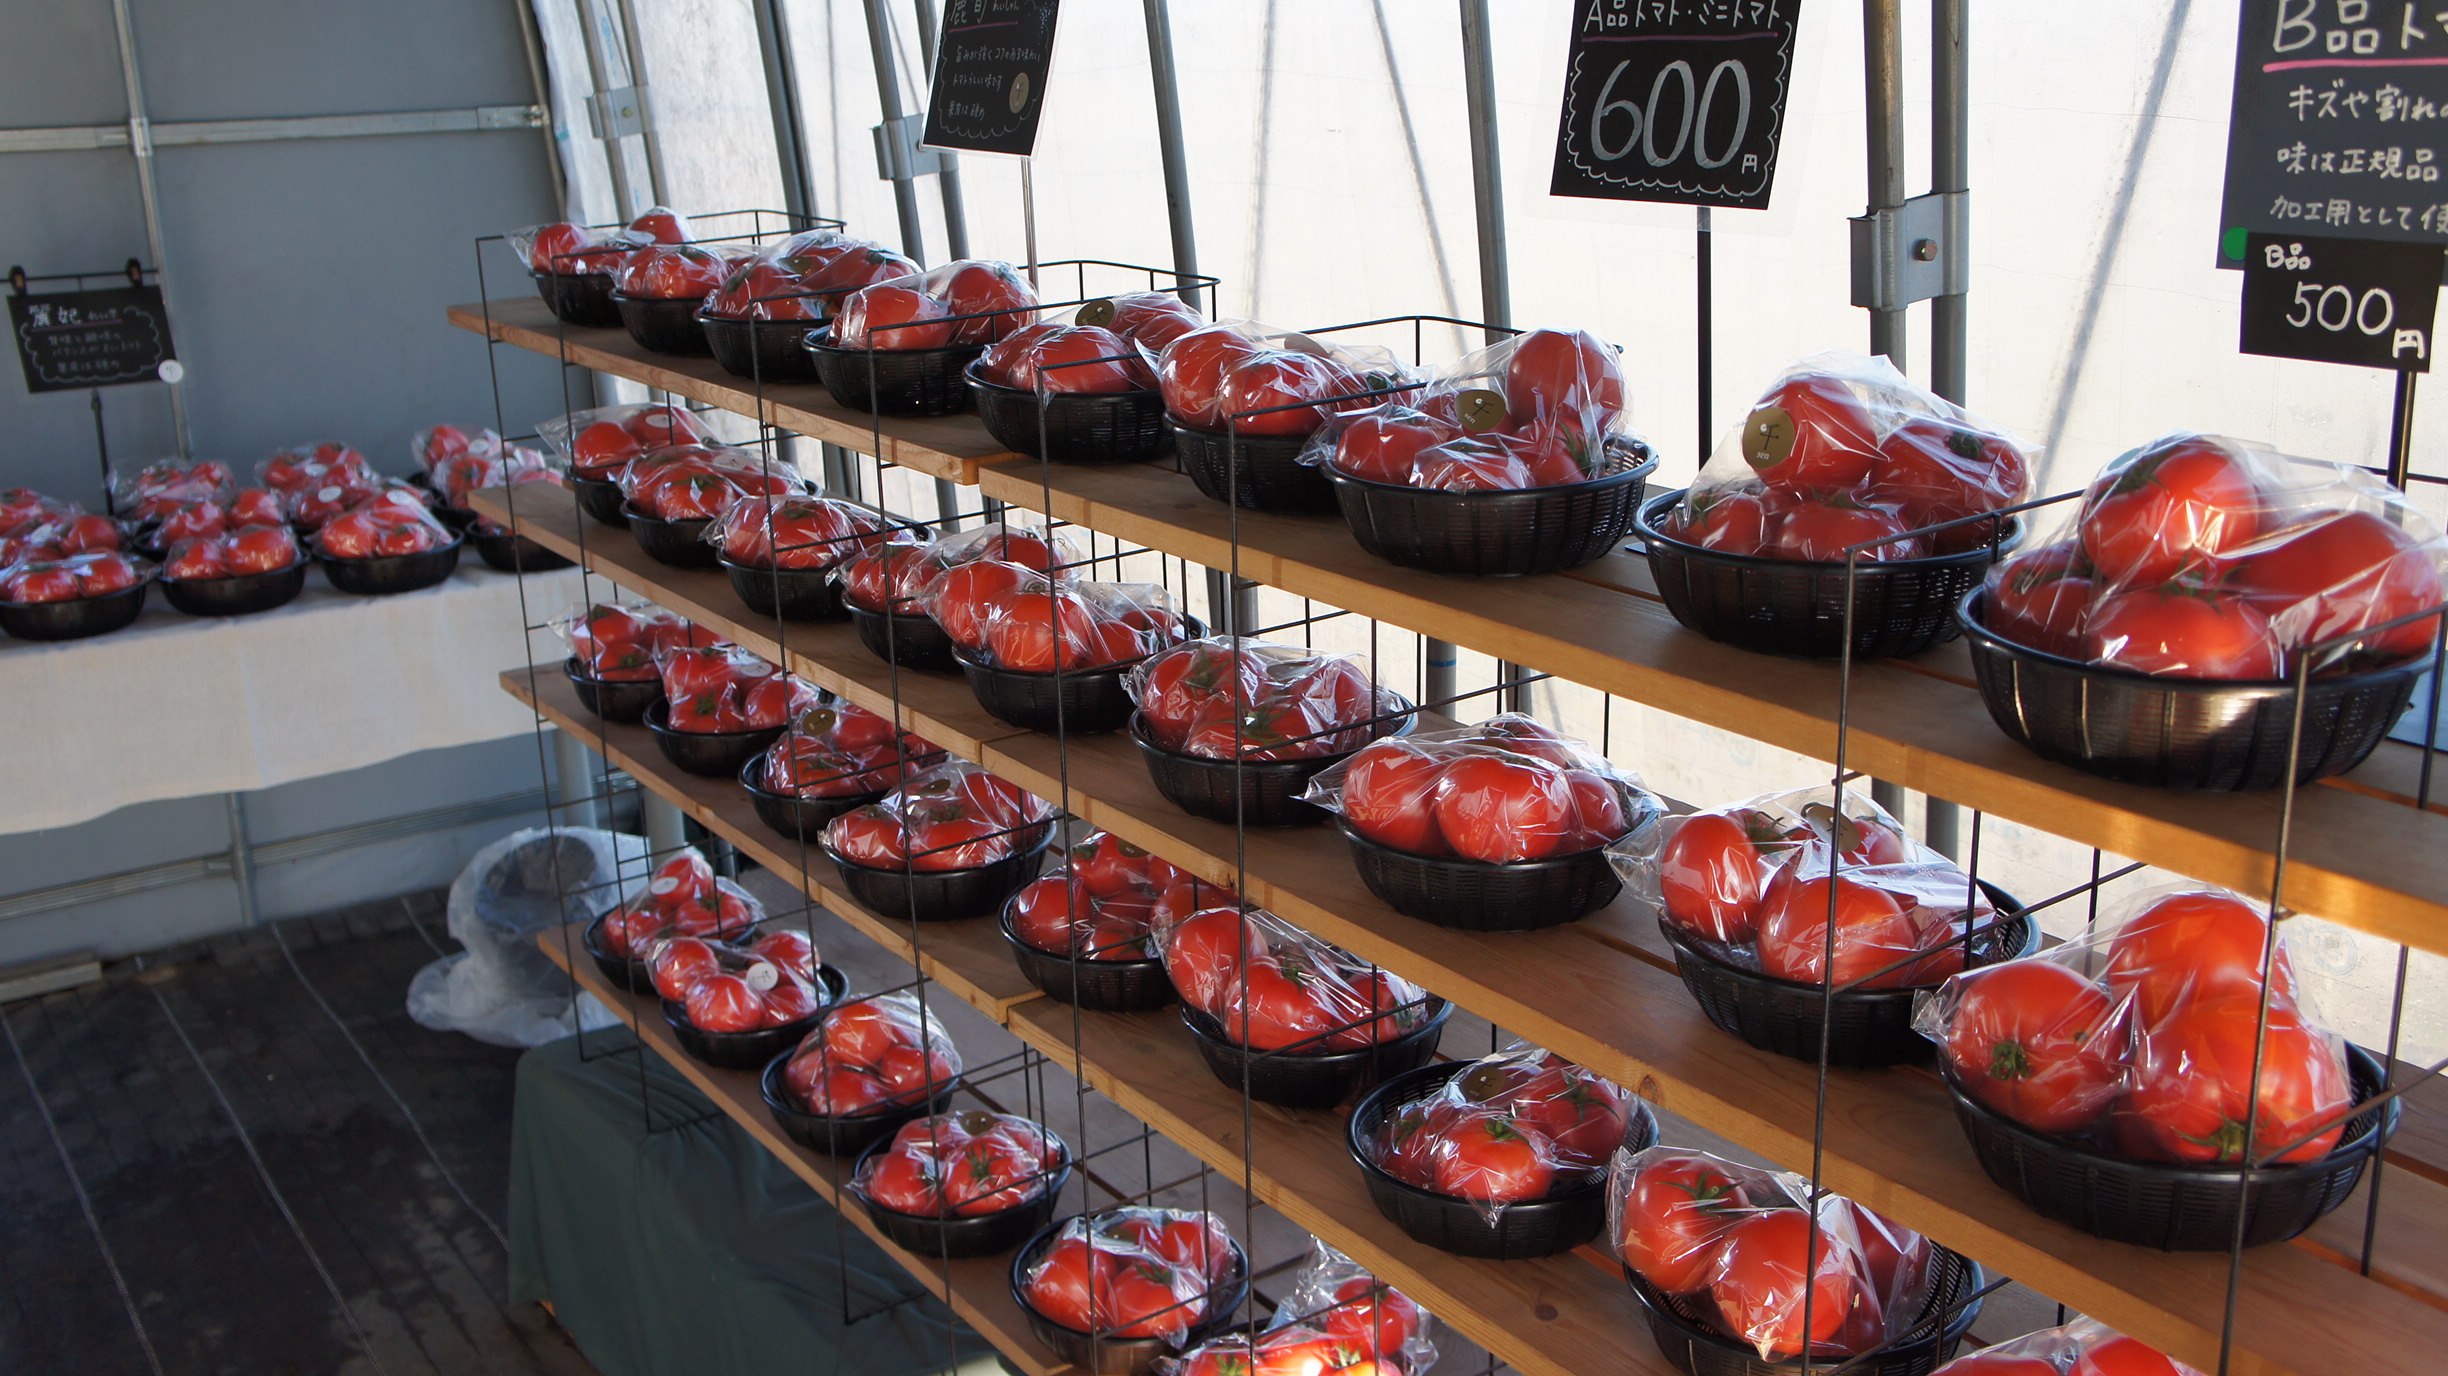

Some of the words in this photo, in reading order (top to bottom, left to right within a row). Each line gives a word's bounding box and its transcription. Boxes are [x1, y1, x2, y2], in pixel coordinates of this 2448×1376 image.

[2276, 141, 2439, 182] 味は正規品
[2265, 243, 2311, 270] B品
[1755, 451, 1770, 460] sen
